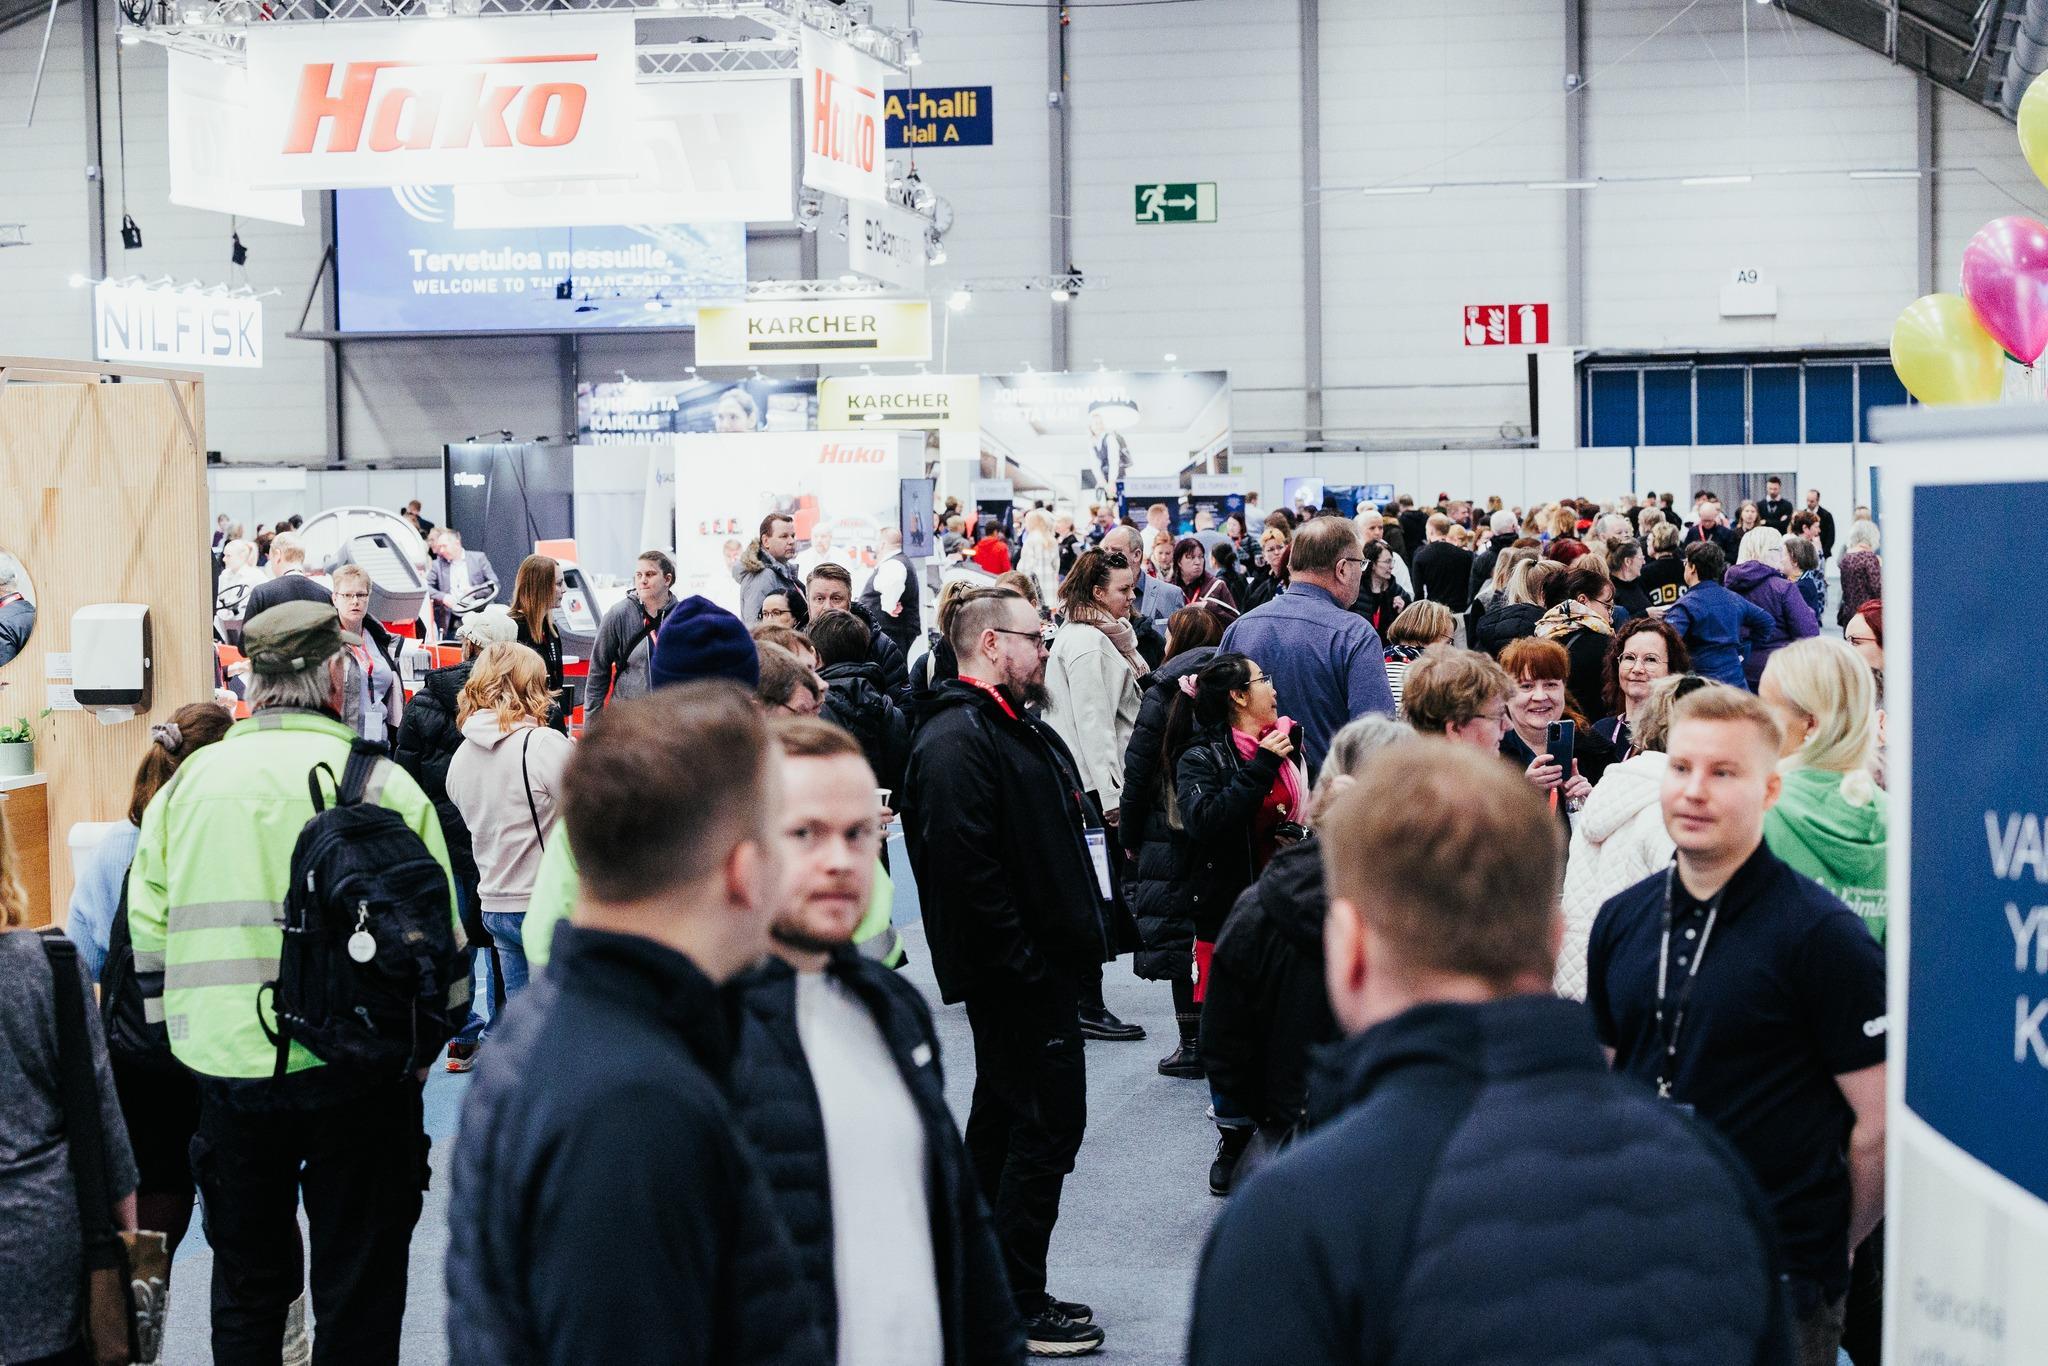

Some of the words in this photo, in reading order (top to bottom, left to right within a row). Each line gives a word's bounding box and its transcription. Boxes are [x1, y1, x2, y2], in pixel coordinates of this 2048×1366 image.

[281, 54, 599, 154] Hako
[884, 91, 977, 120] A-halli
[811, 66, 876, 172] Hako
[903, 123, 937, 144] Hall
[943, 123, 960, 142] A
[408, 247, 543, 272] Tervetuloa
[549, 243, 674, 271] messuille.
[412, 279, 499, 295] WELCOME
[502, 278, 525, 293] TO
[1736, 268, 1758, 285] A9
[103, 301, 256, 358] NILFISK
[818, 442, 888, 464] Hako
[1983, 810, 2048, 884] VA
